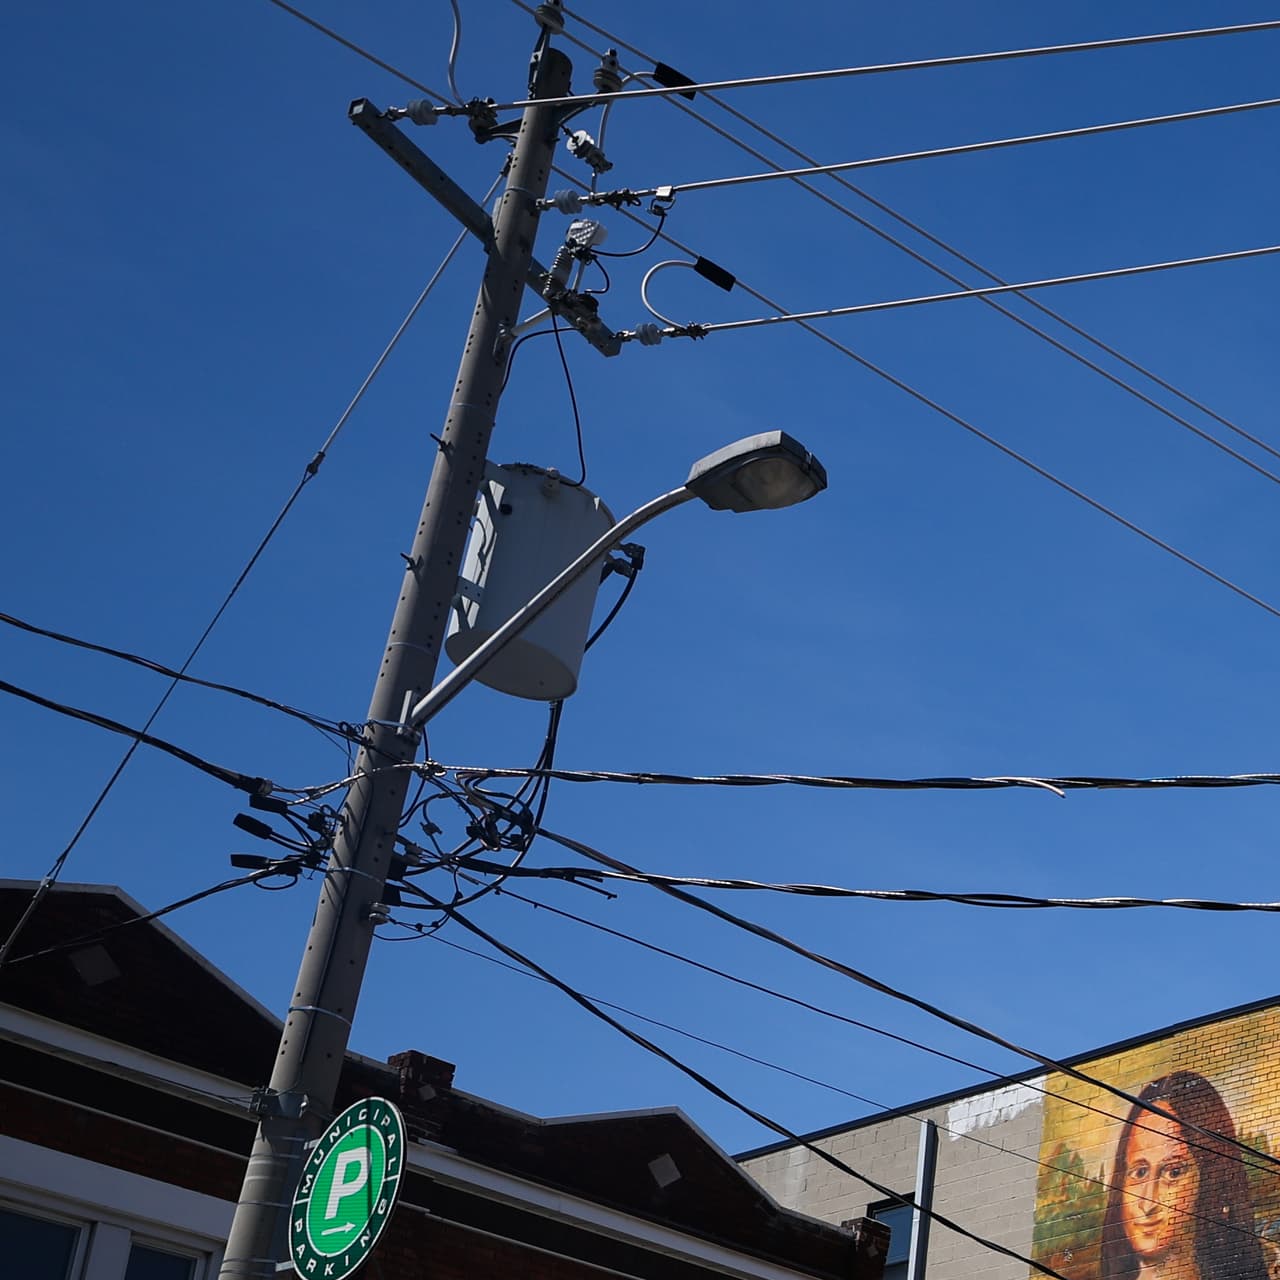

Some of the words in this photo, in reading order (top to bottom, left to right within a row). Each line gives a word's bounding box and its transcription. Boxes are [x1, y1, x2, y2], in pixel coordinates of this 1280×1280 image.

[302, 1109, 397, 1193] MUNICIPAL
[324, 1147, 372, 1220] P
[295, 1199, 387, 1276] PARKING
